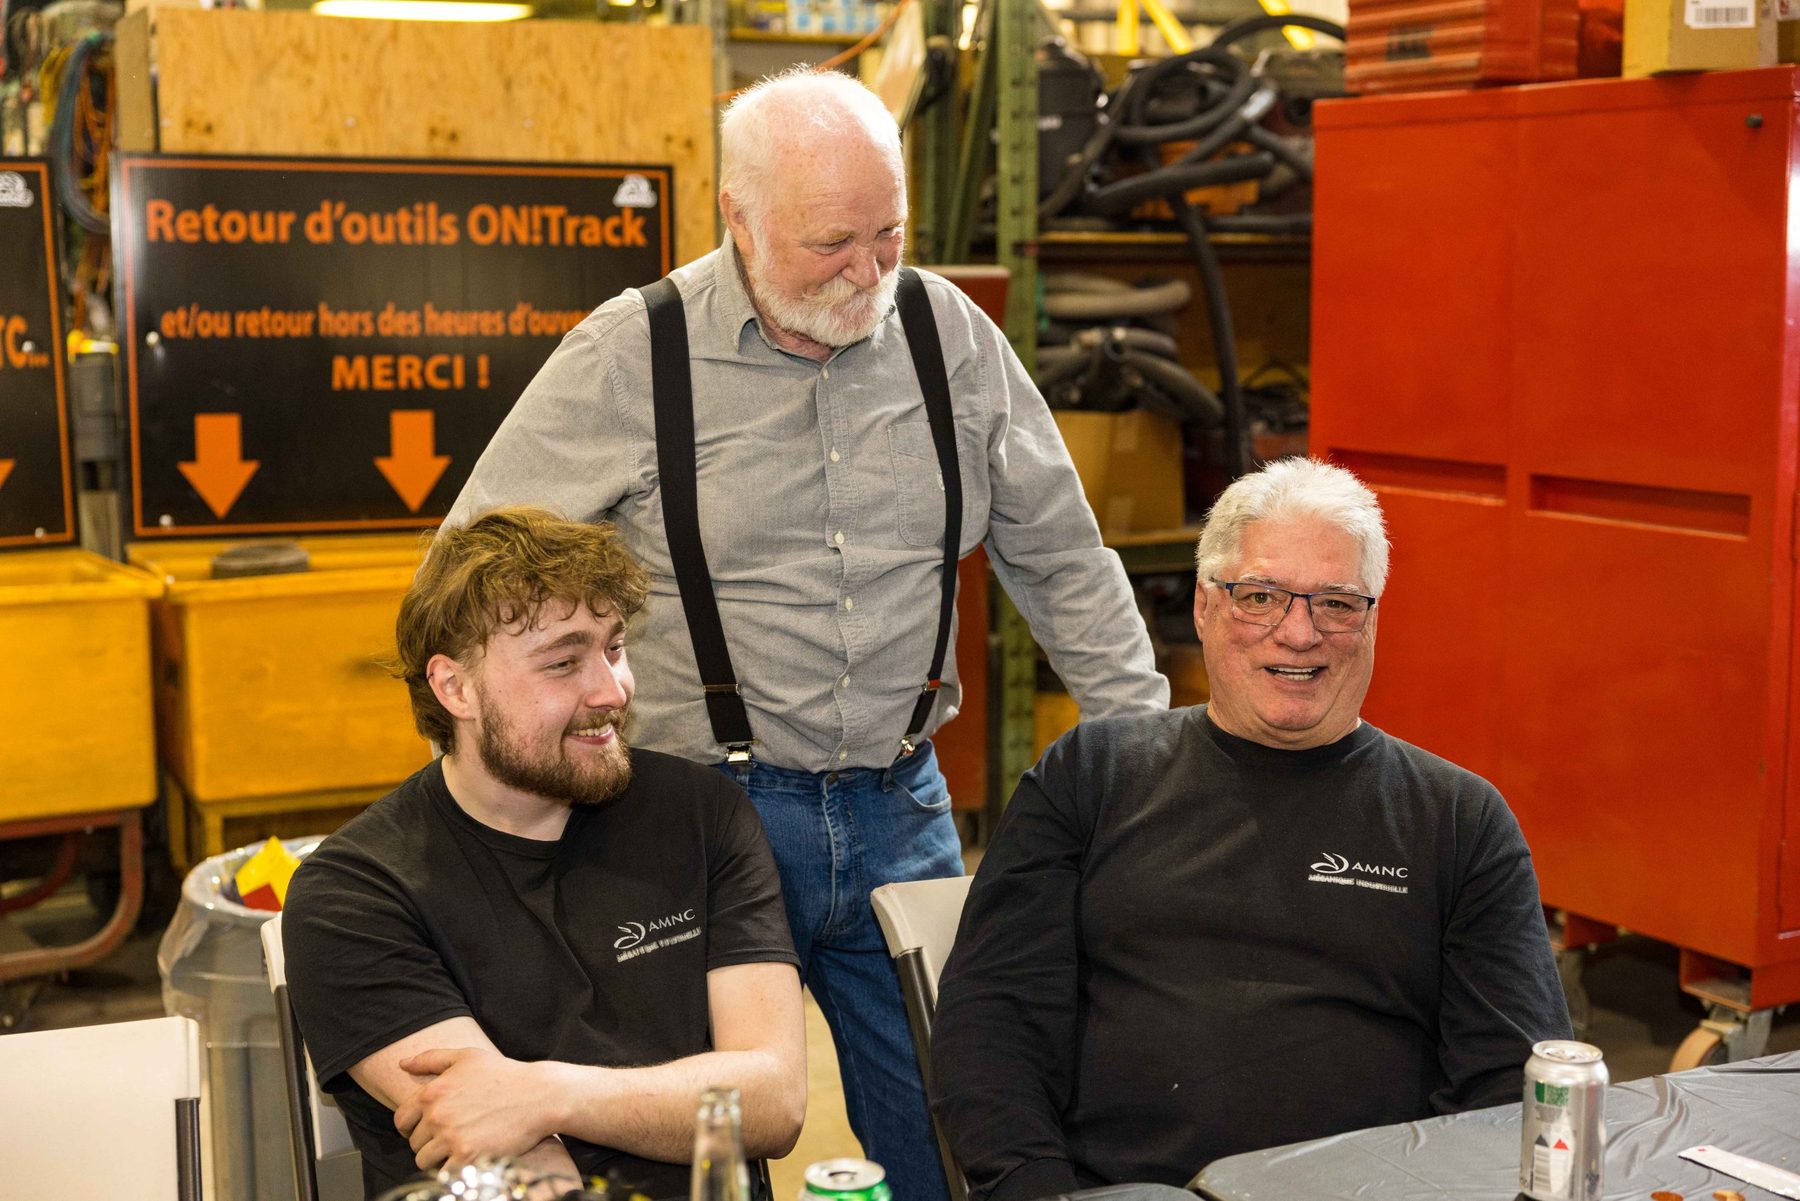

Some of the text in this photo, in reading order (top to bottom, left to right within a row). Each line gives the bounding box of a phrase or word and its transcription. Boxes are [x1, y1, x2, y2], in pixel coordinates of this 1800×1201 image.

[146, 199, 647, 247] Retour d'outils ON!Track
[160, 303, 231, 340] et/ou
[235, 305, 314, 338] retour
[318, 302, 374, 337] hors
[377, 302, 421, 337] des
[424, 302, 505, 336] heures
[332, 354, 490, 390] MERCI !
